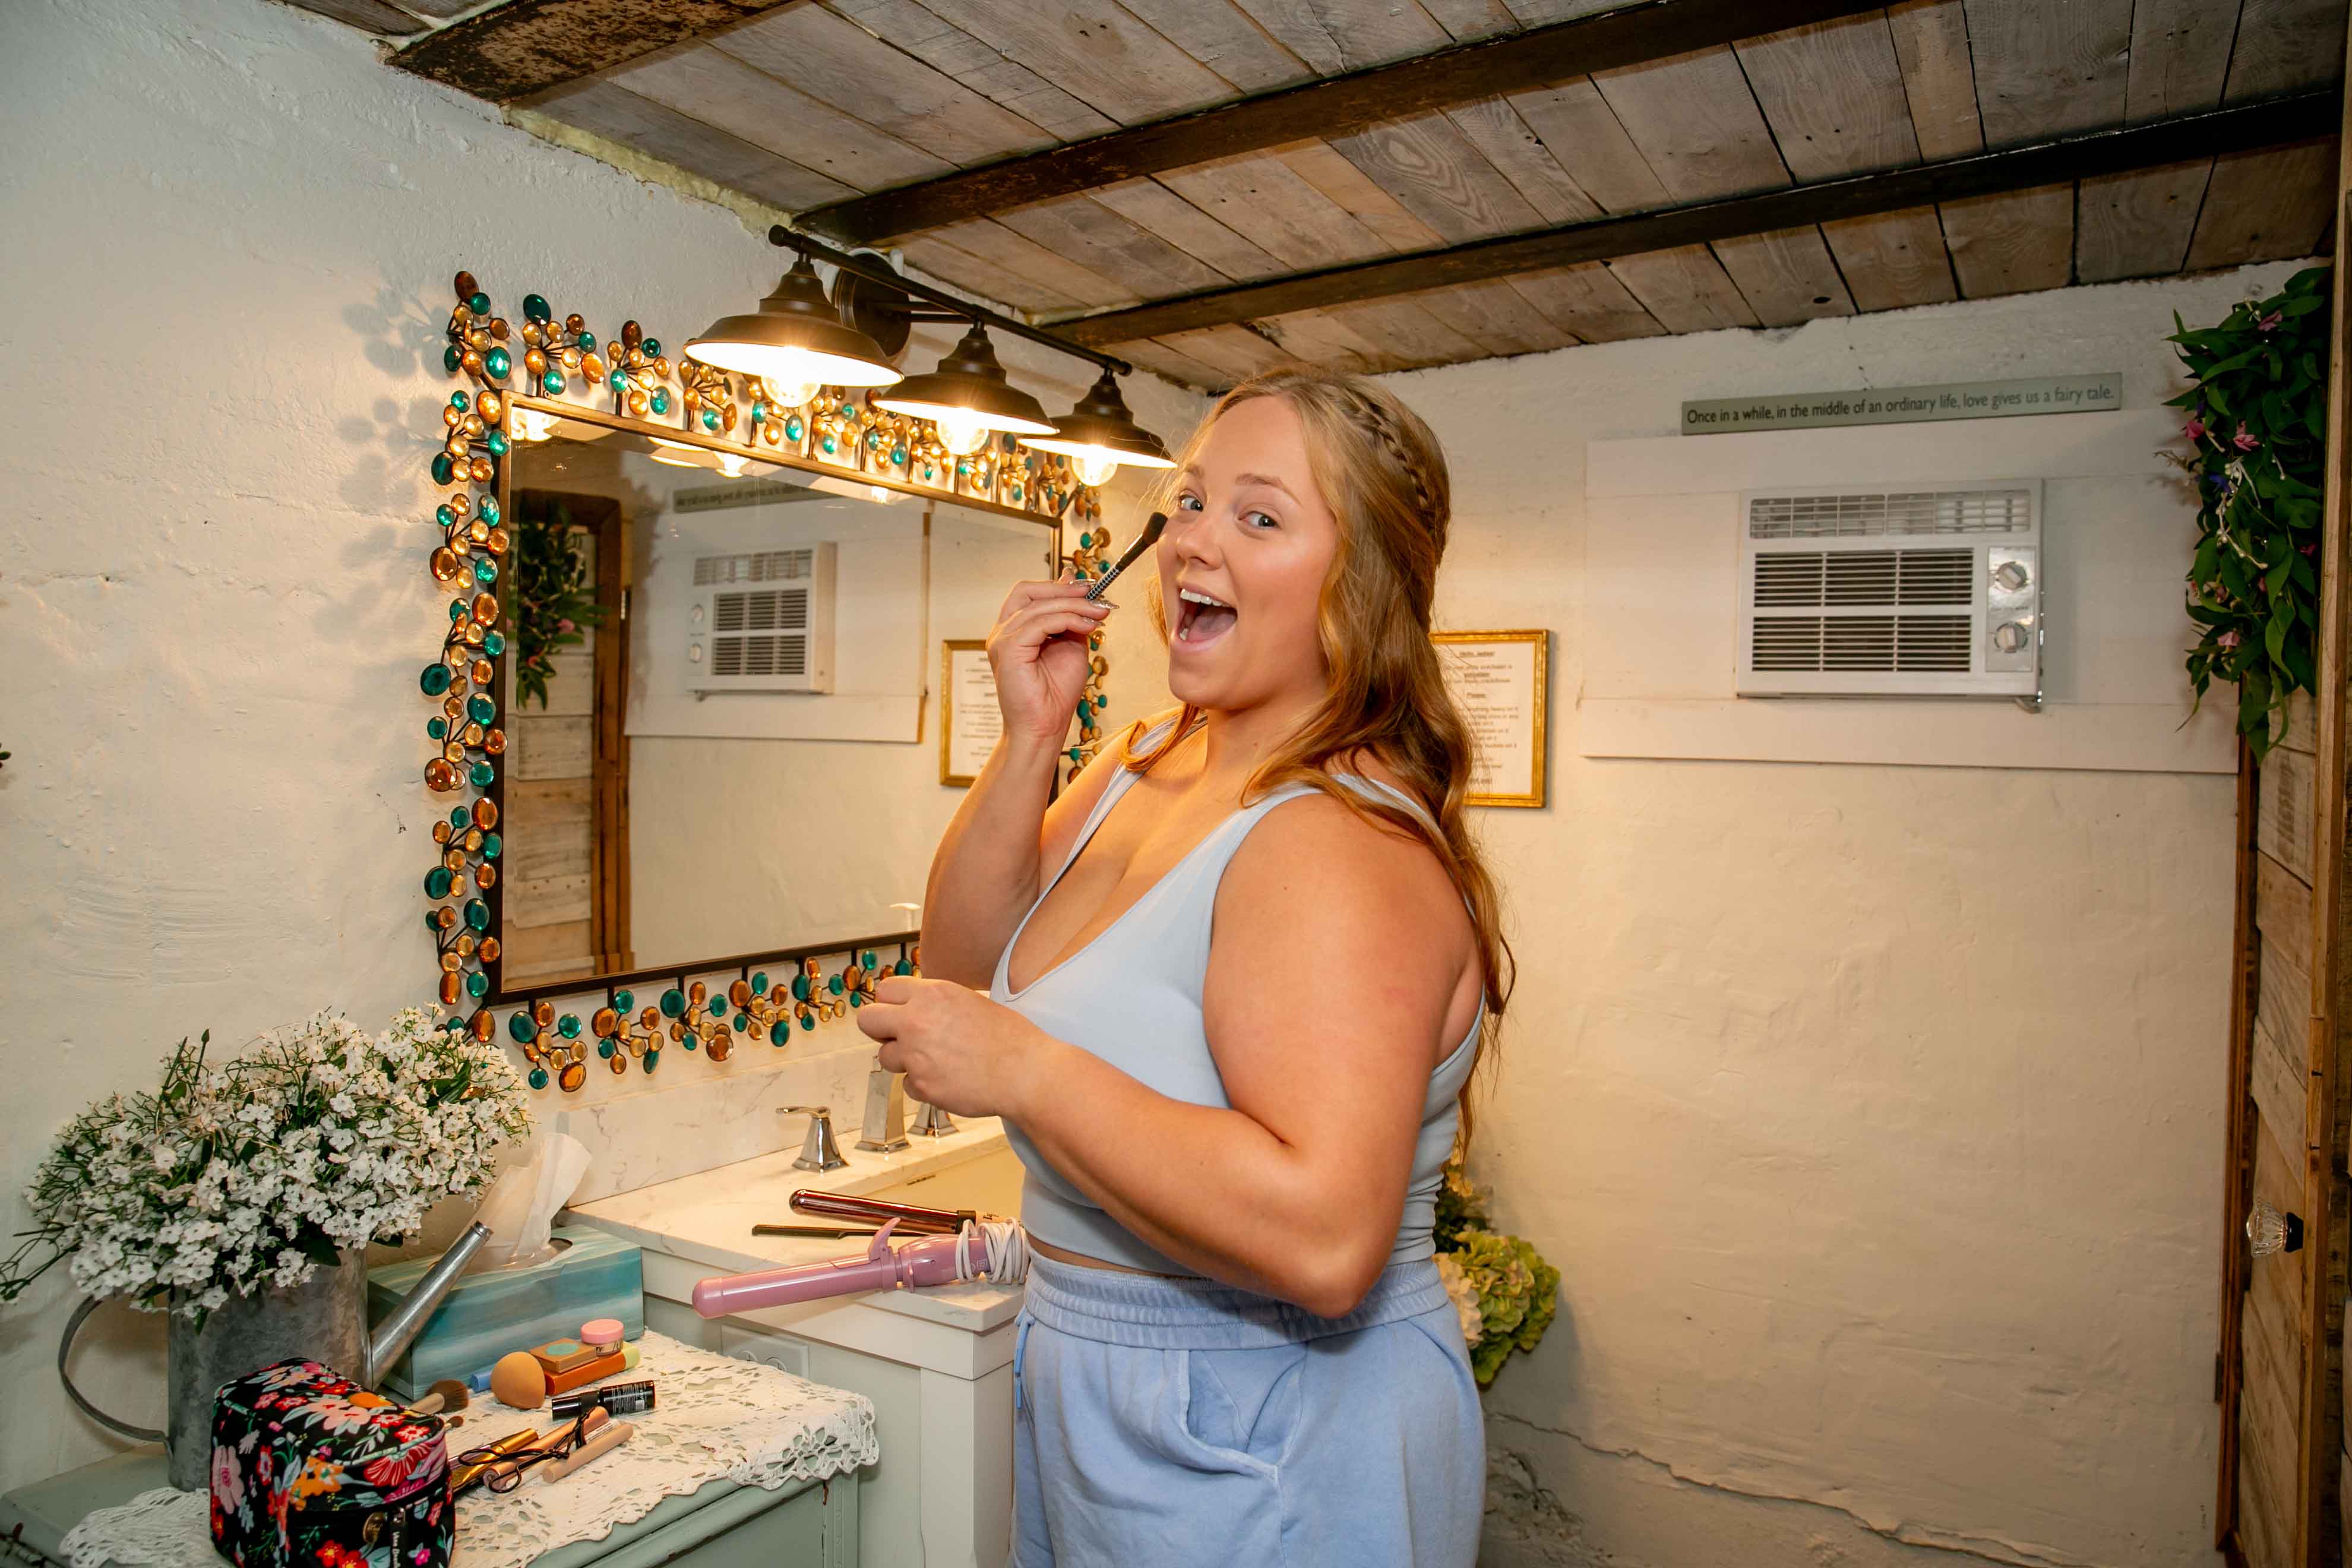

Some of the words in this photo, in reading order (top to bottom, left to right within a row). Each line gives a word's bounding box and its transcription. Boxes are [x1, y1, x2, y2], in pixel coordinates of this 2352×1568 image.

[1687, 409, 1716, 423] Once
[1720, 409, 1730, 421] in
[1733, 412, 1739, 421] a
[1742, 406, 1775, 421] while,
[1777, 406, 1787, 418] in
[1791, 404, 1809, 418] the
[1812, 400, 1850, 416] middle
[1853, 399, 1866, 414] of
[1869, 402, 1882, 413] an
[1886, 396, 1936, 413] ordinary
[1939, 394, 1961, 410] life,
[1963, 393, 1988, 407] love
[1991, 392, 2021, 410] gives
[2026, 393, 2039, 404] us
[2043, 392, 2050, 402] a
[2054, 386, 2084, 405] fairy
[2087, 384, 2114, 400] tale.
